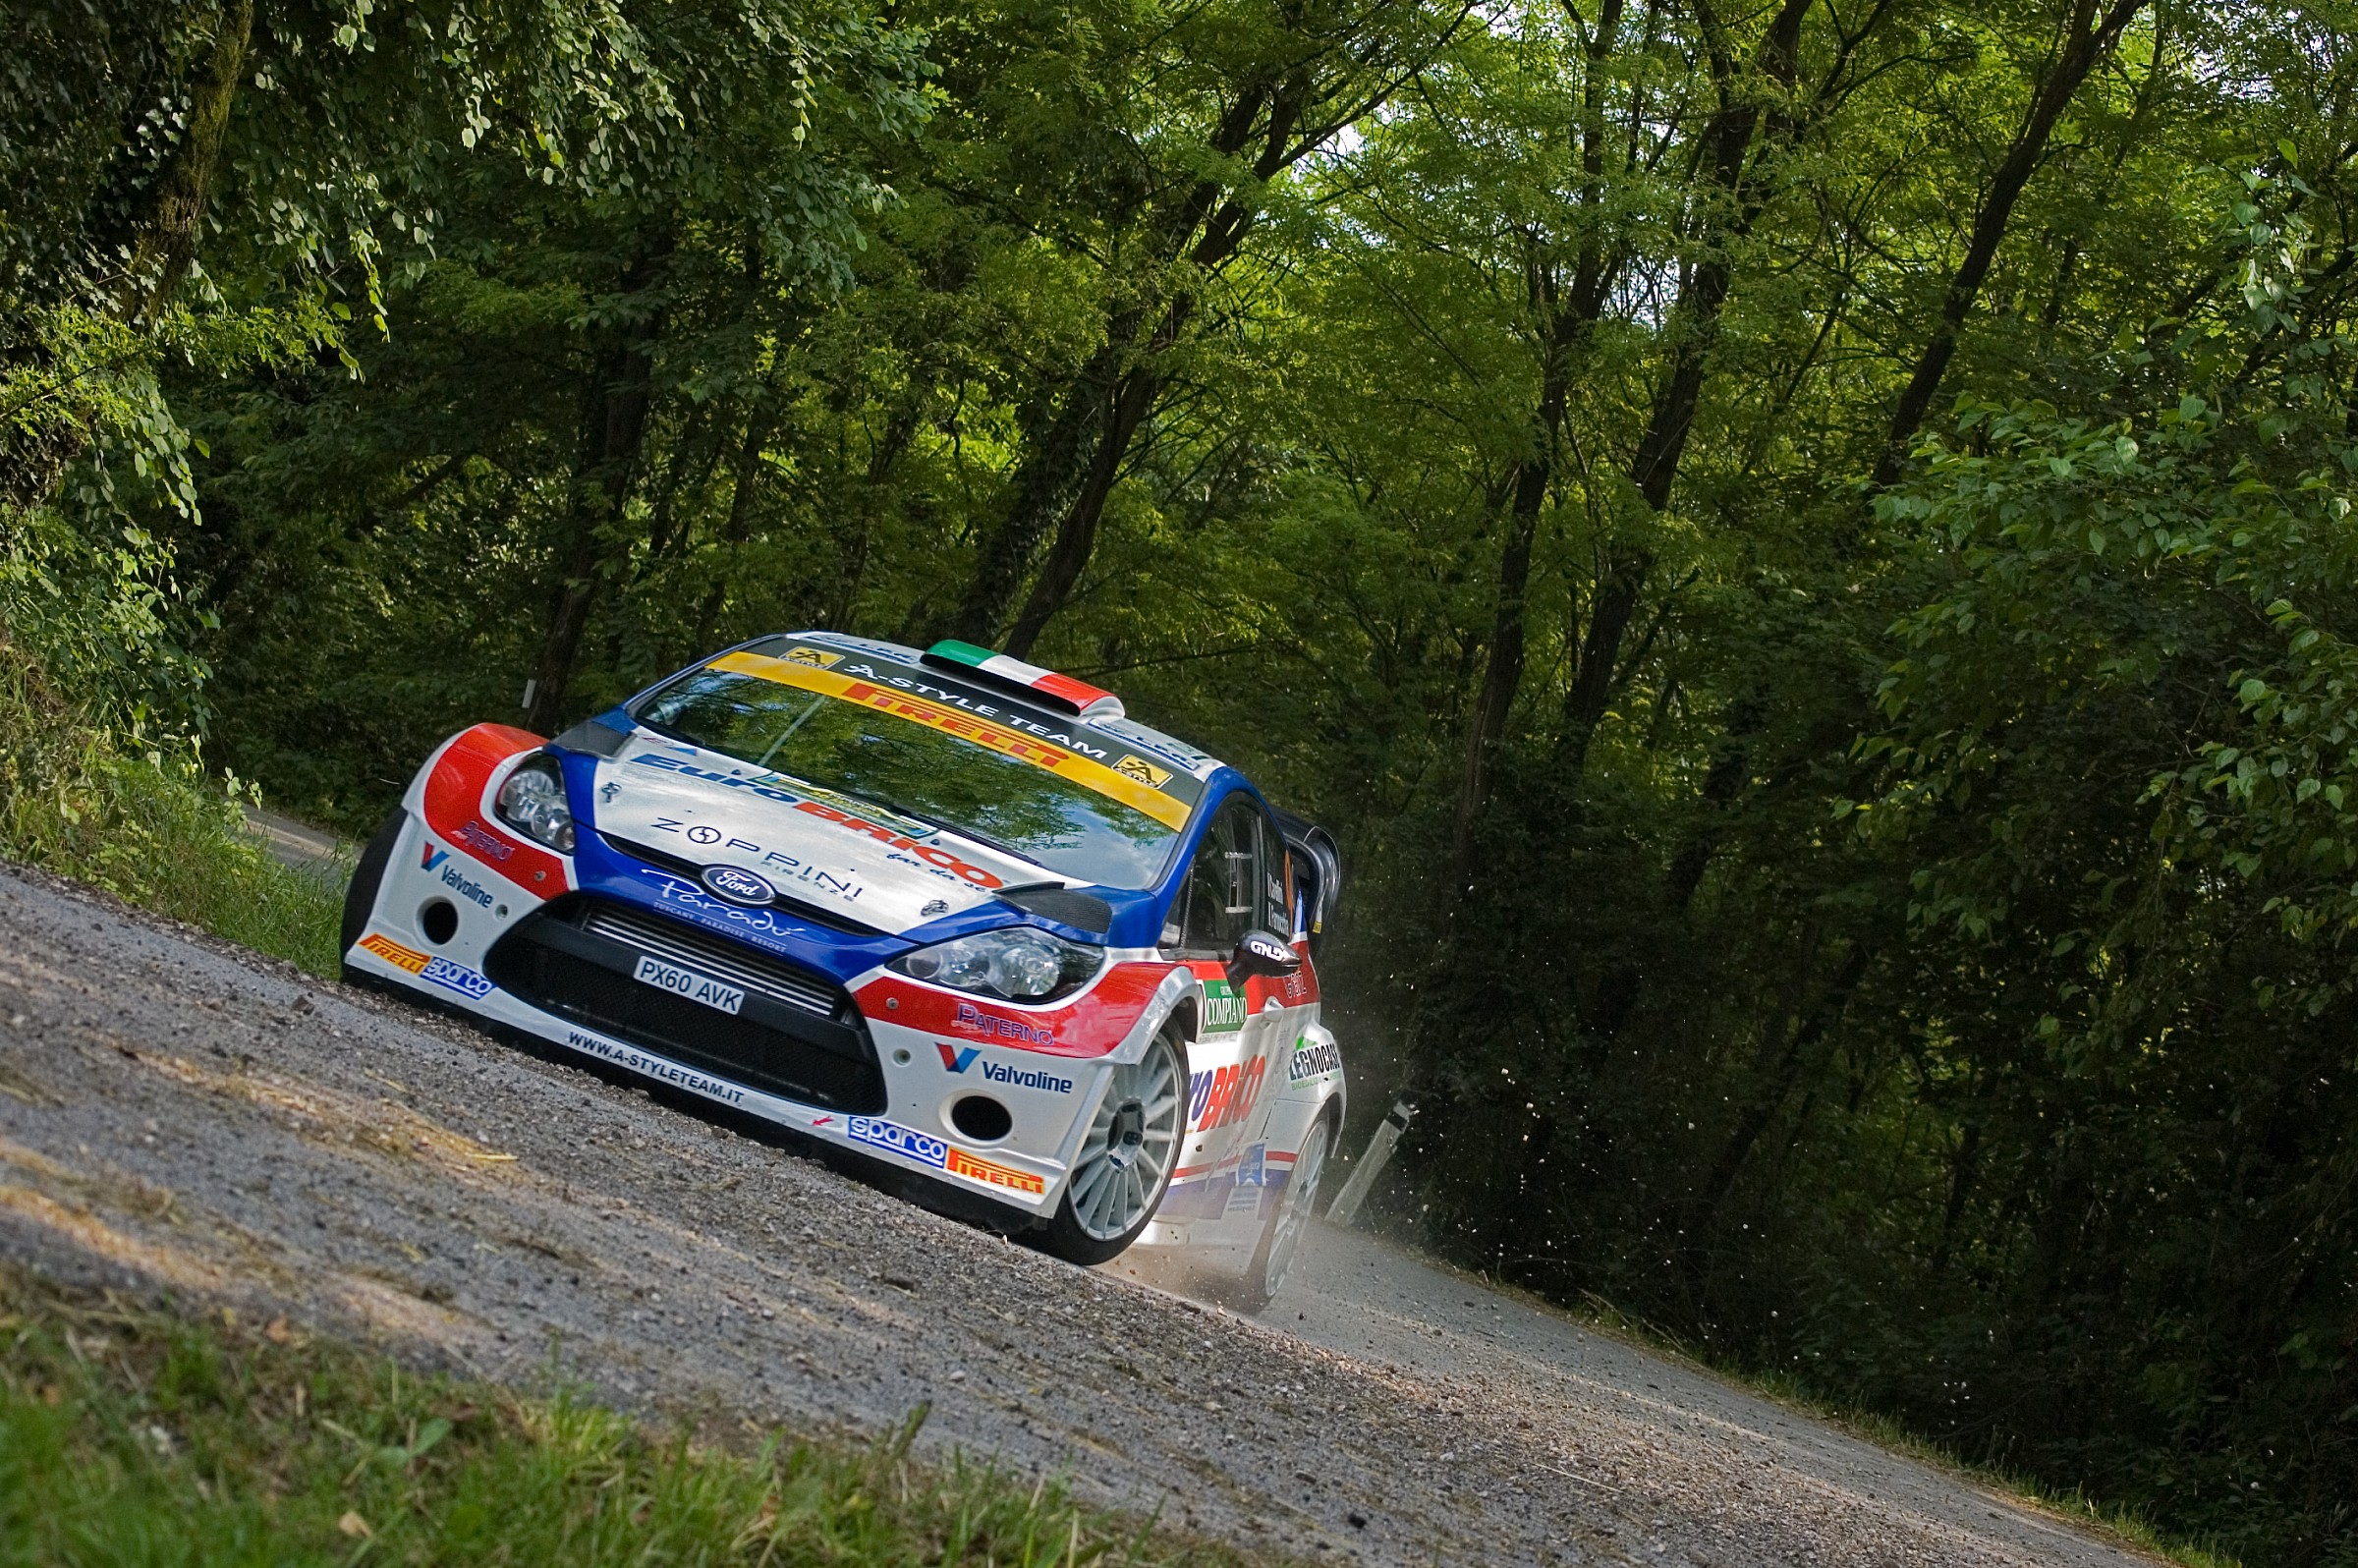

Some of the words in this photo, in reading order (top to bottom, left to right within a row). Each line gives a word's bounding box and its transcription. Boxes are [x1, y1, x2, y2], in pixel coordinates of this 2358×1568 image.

[842, 683, 1070, 767] PIRELLI
[843, 663, 999, 717] A-STYLE
[1010, 714, 1108, 760] TEAM
[649, 816, 863, 897] ZOPPINI
[441, 865, 494, 909] Valvoline
[715, 869, 760, 896] Ford
[653, 901, 696, 920] TUSCANY
[701, 918, 744, 938] PARADISE
[752, 935, 787, 954] RESORT
[358, 933, 432, 975] PIRELLI
[426, 958, 492, 994] sparco
[640, 960, 692, 993] PX60
[696, 982, 741, 1011] AVK
[957, 1002, 1054, 1046] PATERNO
[1207, 996, 1248, 1026] COMPIANO
[568, 1032, 744, 1102] WWW.A-STYLETEAM.IT
[982, 1061, 1073, 1093] Valvoline
[850, 1117, 946, 1159] sparco
[947, 1148, 1044, 1194] PIRELLI
